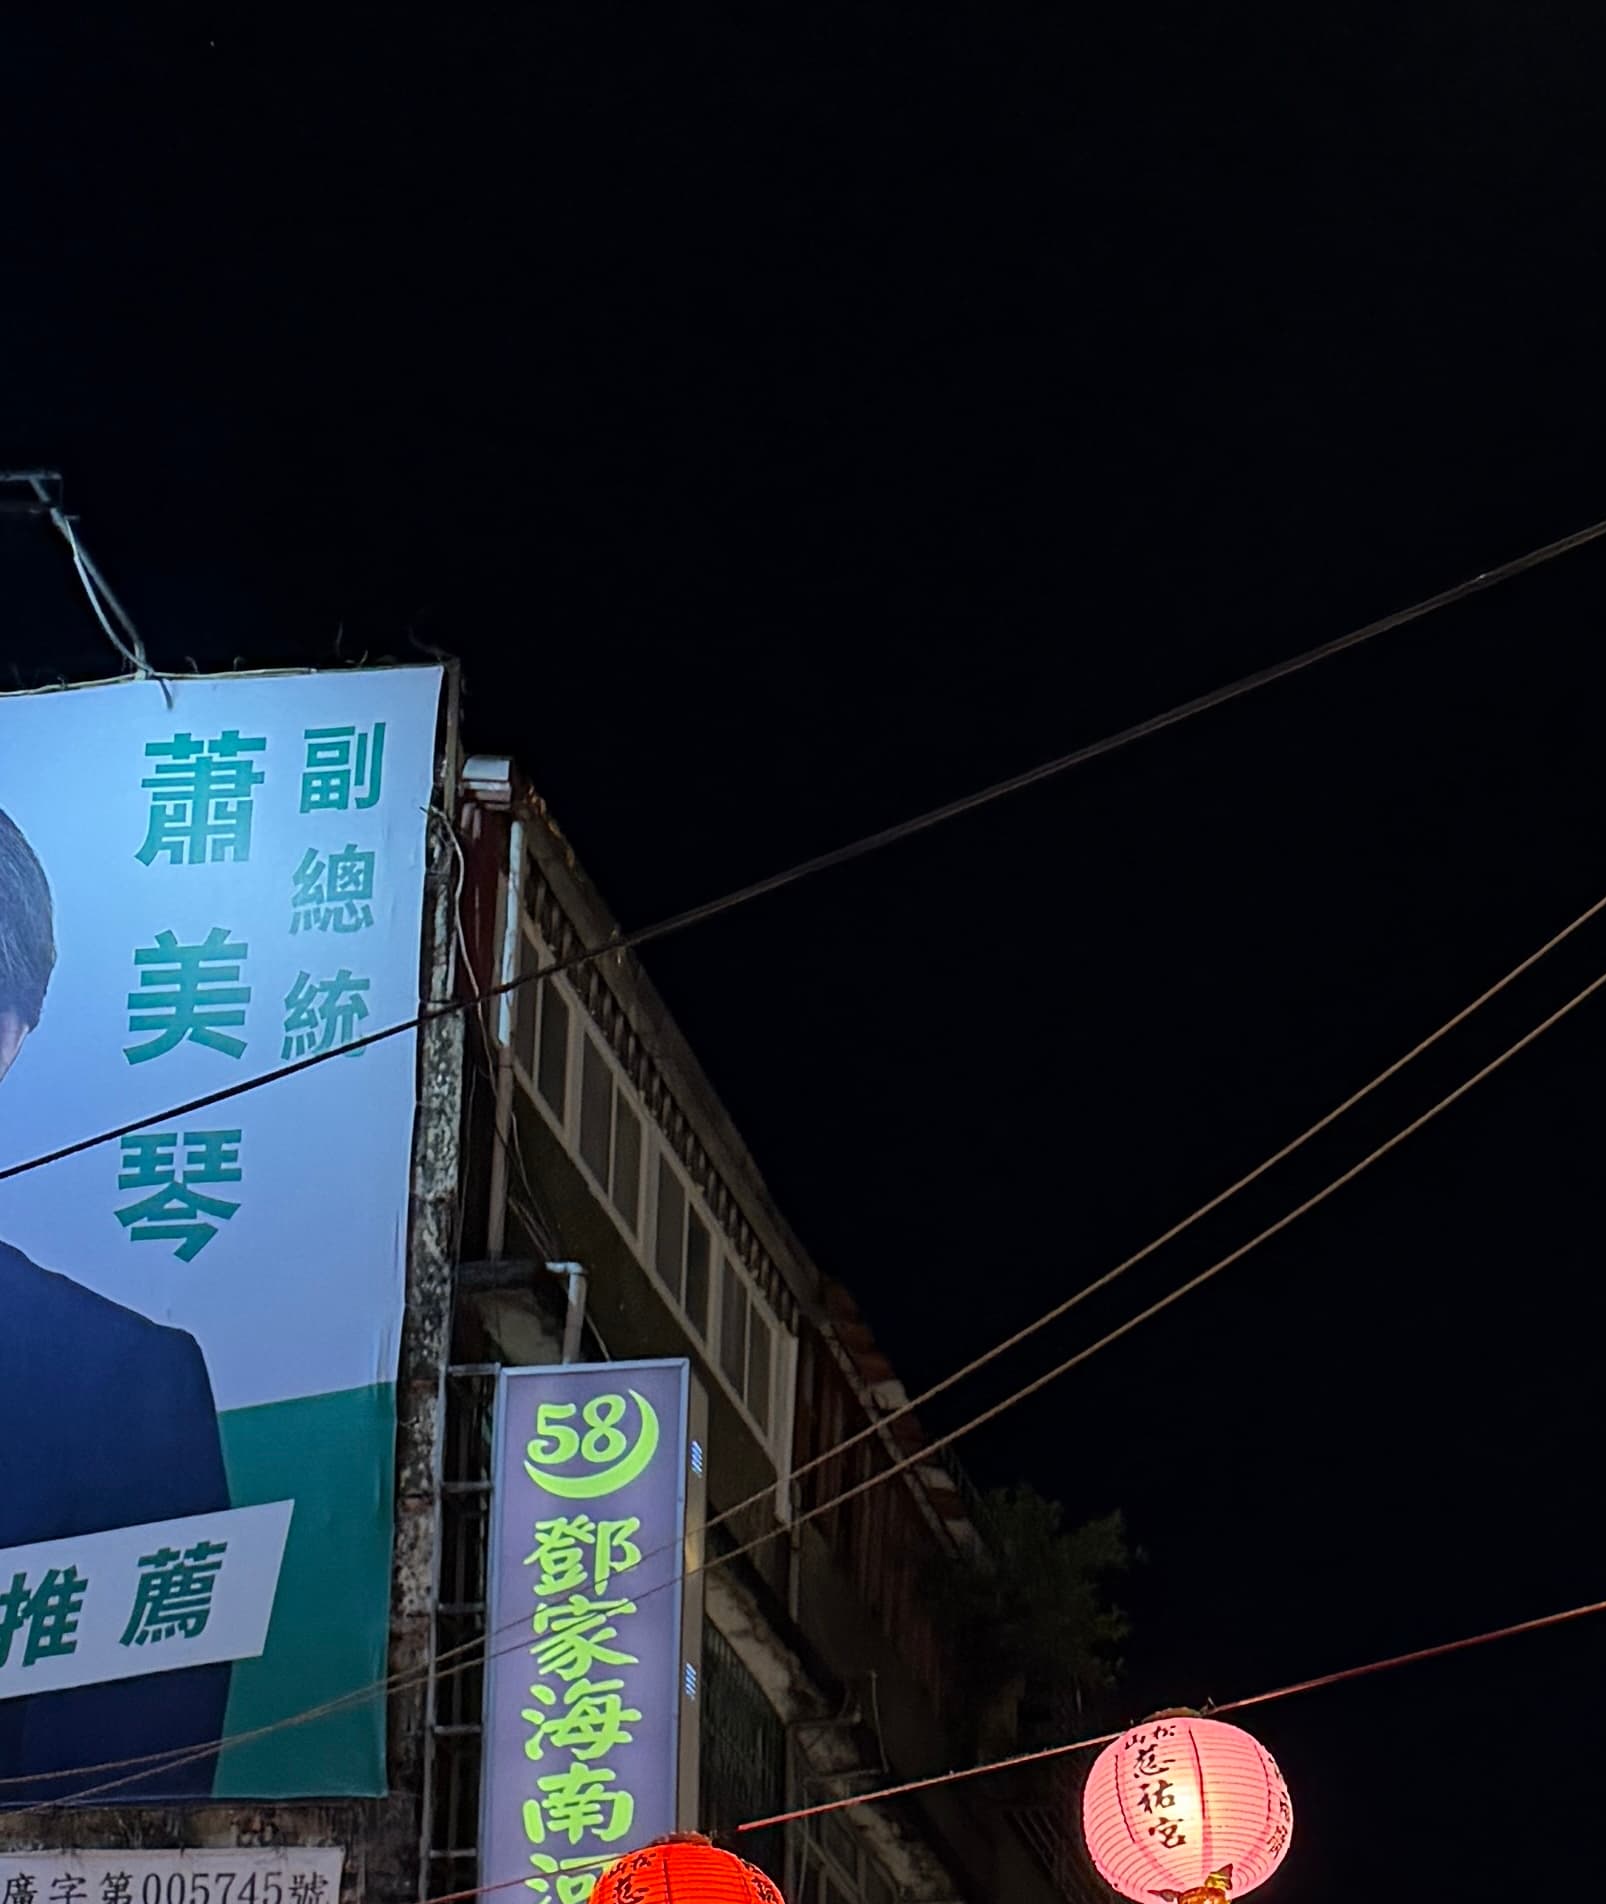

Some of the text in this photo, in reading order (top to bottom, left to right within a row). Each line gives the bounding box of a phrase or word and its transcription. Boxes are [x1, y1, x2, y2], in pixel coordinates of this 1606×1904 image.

[114, 730, 267, 1263] 蕭美琴
[280, 722, 387, 1062] 副總統
[527, 1393, 627, 1467] 58
[0, 1540, 230, 1668] 推薦
